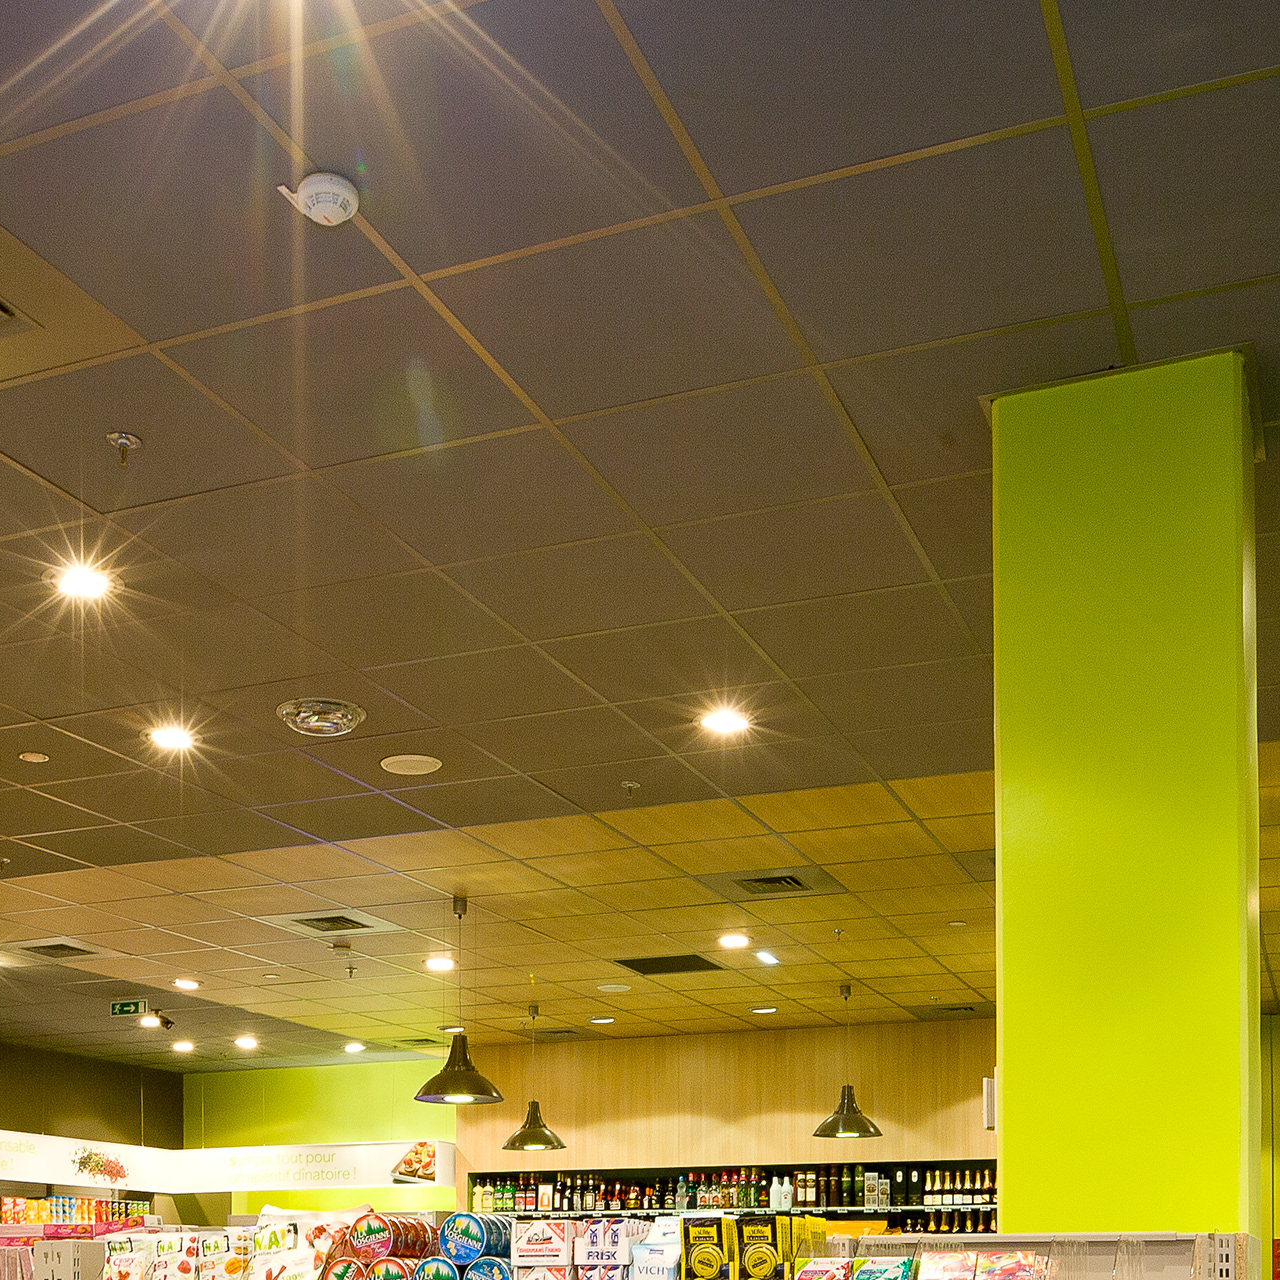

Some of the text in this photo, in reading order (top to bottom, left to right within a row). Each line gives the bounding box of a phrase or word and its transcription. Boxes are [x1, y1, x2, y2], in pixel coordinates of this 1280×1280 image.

[277, 1153, 303, 1165] tout
[306, 1153, 336, 1166] pour
[293, 1167, 350, 1182] dînatoire
[350, 1230, 390, 1246] VOSGIENNE
[445, 1223, 482, 1250] VOSGIENNE
[587, 1250, 617, 1260] FRISK
